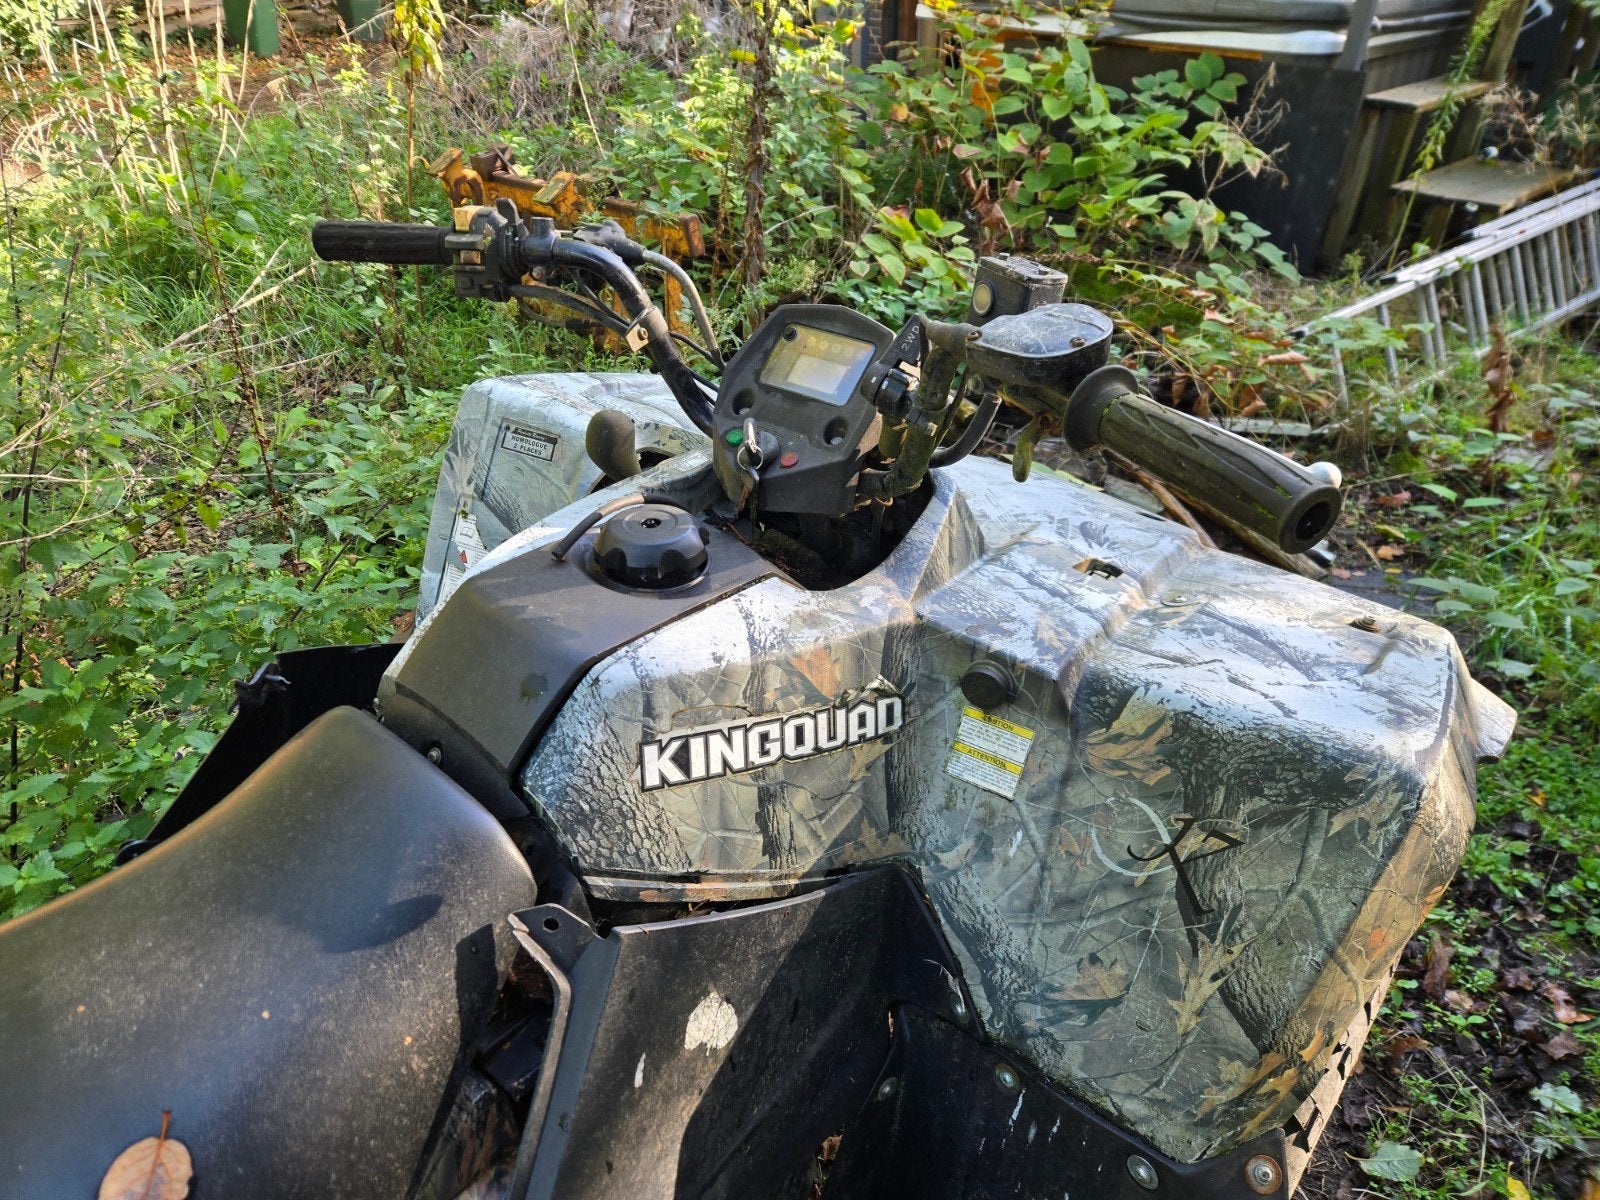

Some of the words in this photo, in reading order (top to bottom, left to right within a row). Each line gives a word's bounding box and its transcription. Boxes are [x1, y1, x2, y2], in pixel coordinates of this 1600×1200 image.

[902, 325, 920, 350] 2WD
[519, 444, 542, 456] PLACES
[982, 714, 1014, 732] CAUTION
[641, 694, 904, 793] KINGQUAD
[968, 749, 1006, 769] ATTENTION
